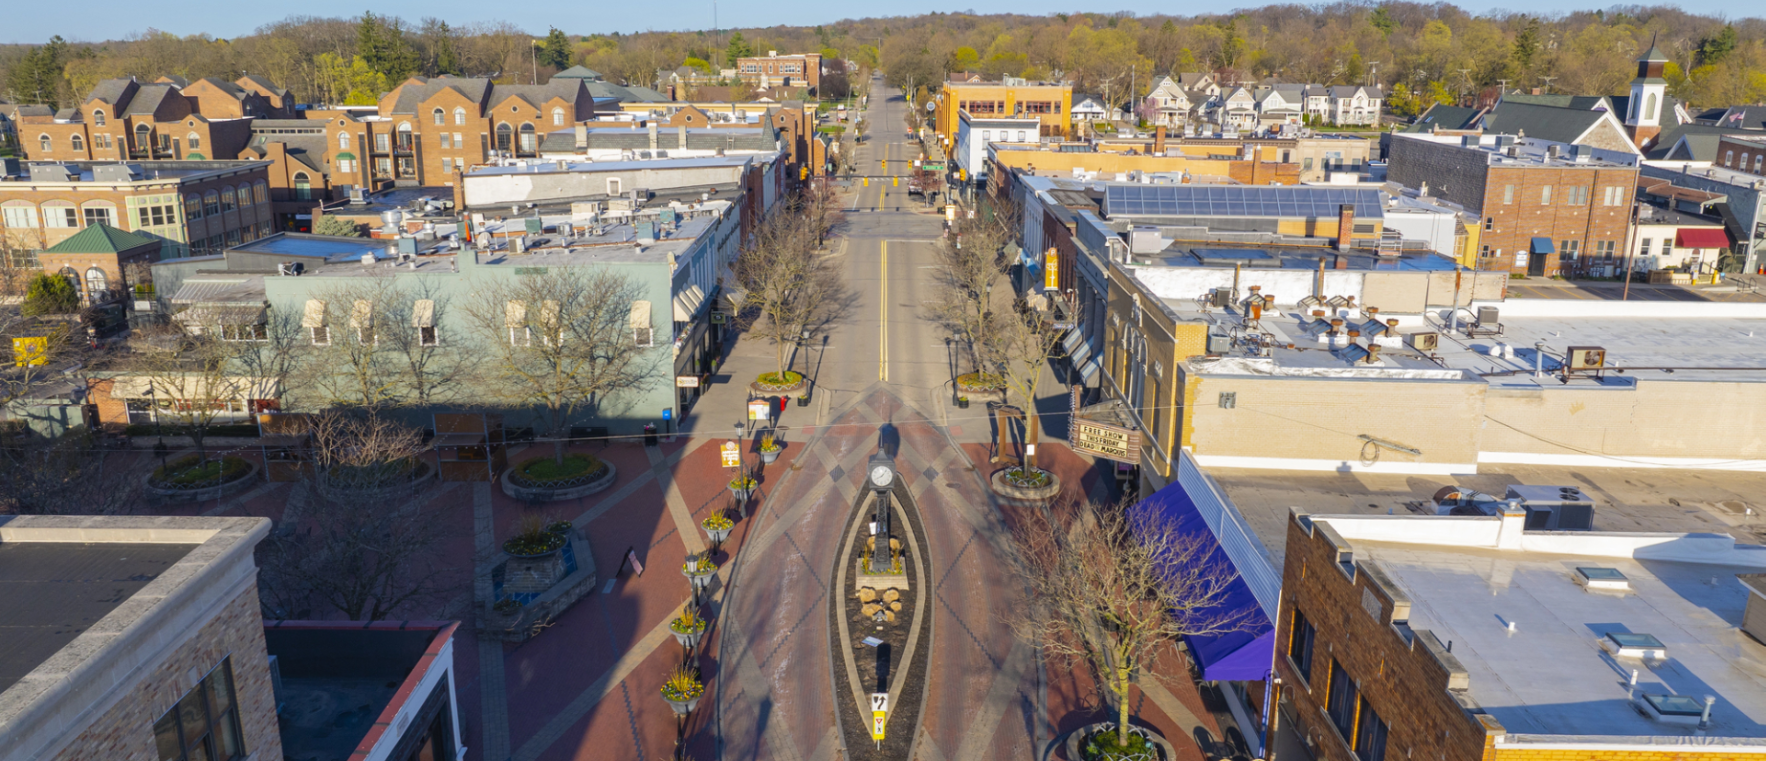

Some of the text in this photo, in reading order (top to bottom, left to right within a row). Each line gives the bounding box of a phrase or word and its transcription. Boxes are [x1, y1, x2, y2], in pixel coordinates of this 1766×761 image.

[1084, 427, 1123, 439] FREE SHOW
[1080, 441, 1095, 449] DEAD
[1086, 434, 1120, 447] THIS FRIDAY
